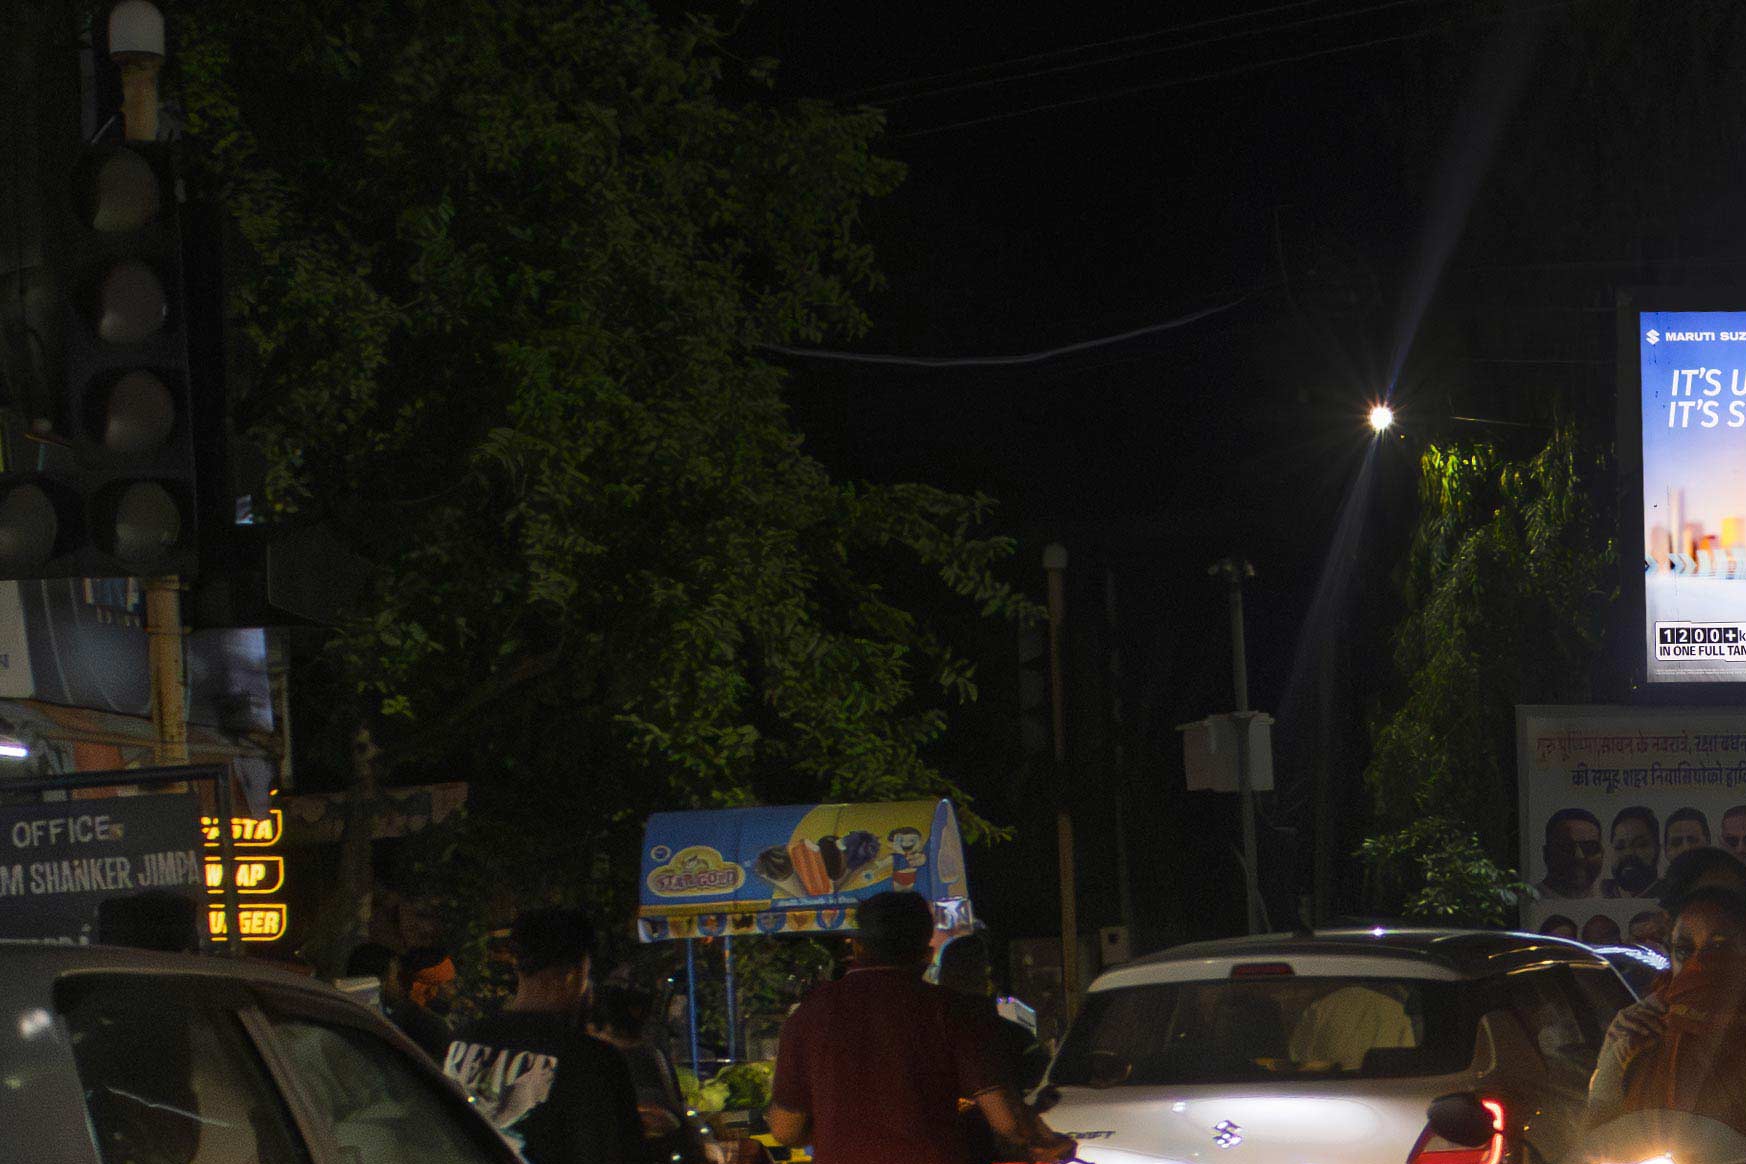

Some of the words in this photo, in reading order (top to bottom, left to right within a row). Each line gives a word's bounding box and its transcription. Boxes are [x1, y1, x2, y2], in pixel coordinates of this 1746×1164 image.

[1665, 331, 1716, 342] MARUTI
[1671, 367, 1722, 397] IT'S
[1668, 400, 1719, 428] IT'S
[1659, 646, 1671, 656] IN
[1673, 645, 1696, 656] ONE
[1699, 645, 1725, 656] FULL
[12, 815, 110, 848] OFFICE
[205, 863, 266, 887] WAP
